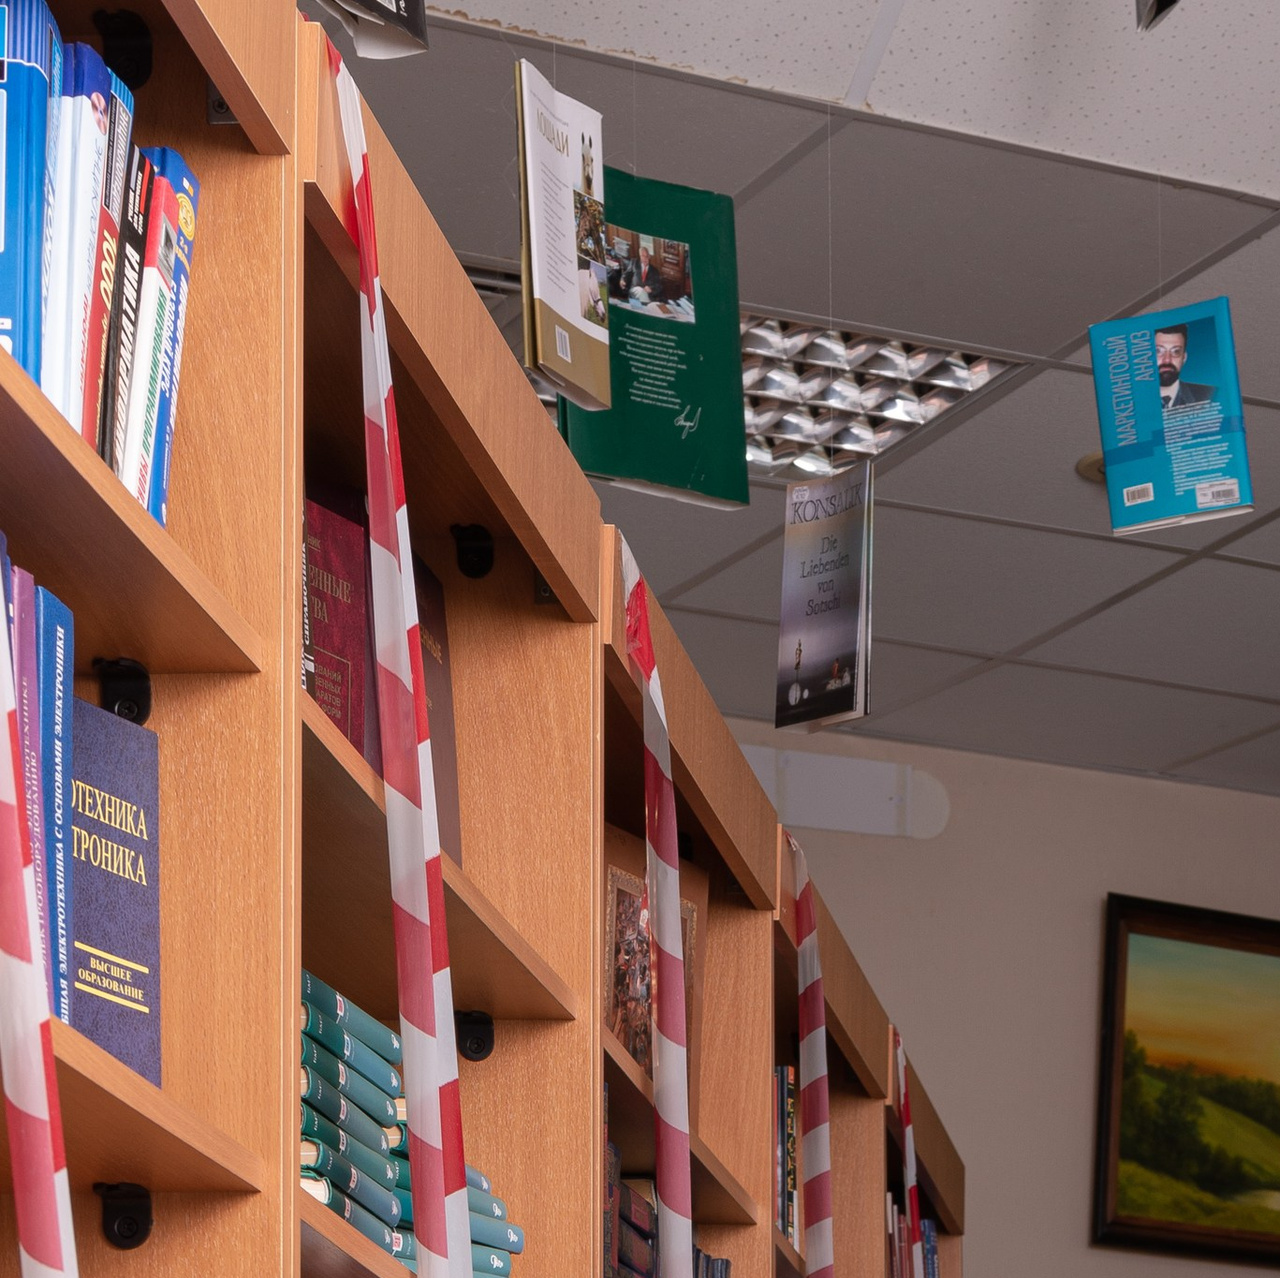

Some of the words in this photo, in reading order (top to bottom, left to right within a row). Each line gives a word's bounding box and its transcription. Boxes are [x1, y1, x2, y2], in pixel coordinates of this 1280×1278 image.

[112, 107, 130, 222] ЭНЦИКЛОПЕДИЯ
[100, 228, 117, 313] 1000
[141, 286, 167, 456] ПРОГРАММИРОВАНИЯ
[161, 361, 173, 398] КУРС
[1130, 330, 1155, 381] АНАЛИЗ
[1102, 335, 1137, 447] МАРКЕТИНГОВЫЙ
[790, 483, 862, 525] KONSALIK
[800, 555, 850, 579] Liebenden
[819, 536, 838, 555] Die
[817, 578, 834, 595] von
[52, 625, 66, 738] ЭЛЕКТРОНИКИ
[53, 740, 64, 825] ОСНОВАМИ
[55, 842, 69, 975] ЭЛЕКТРОТЕХНИКА
[78, 966, 146, 1003] ОБРАЗОВАНИЕ
[90, 955, 133, 983] ВЫСШЕЕ
